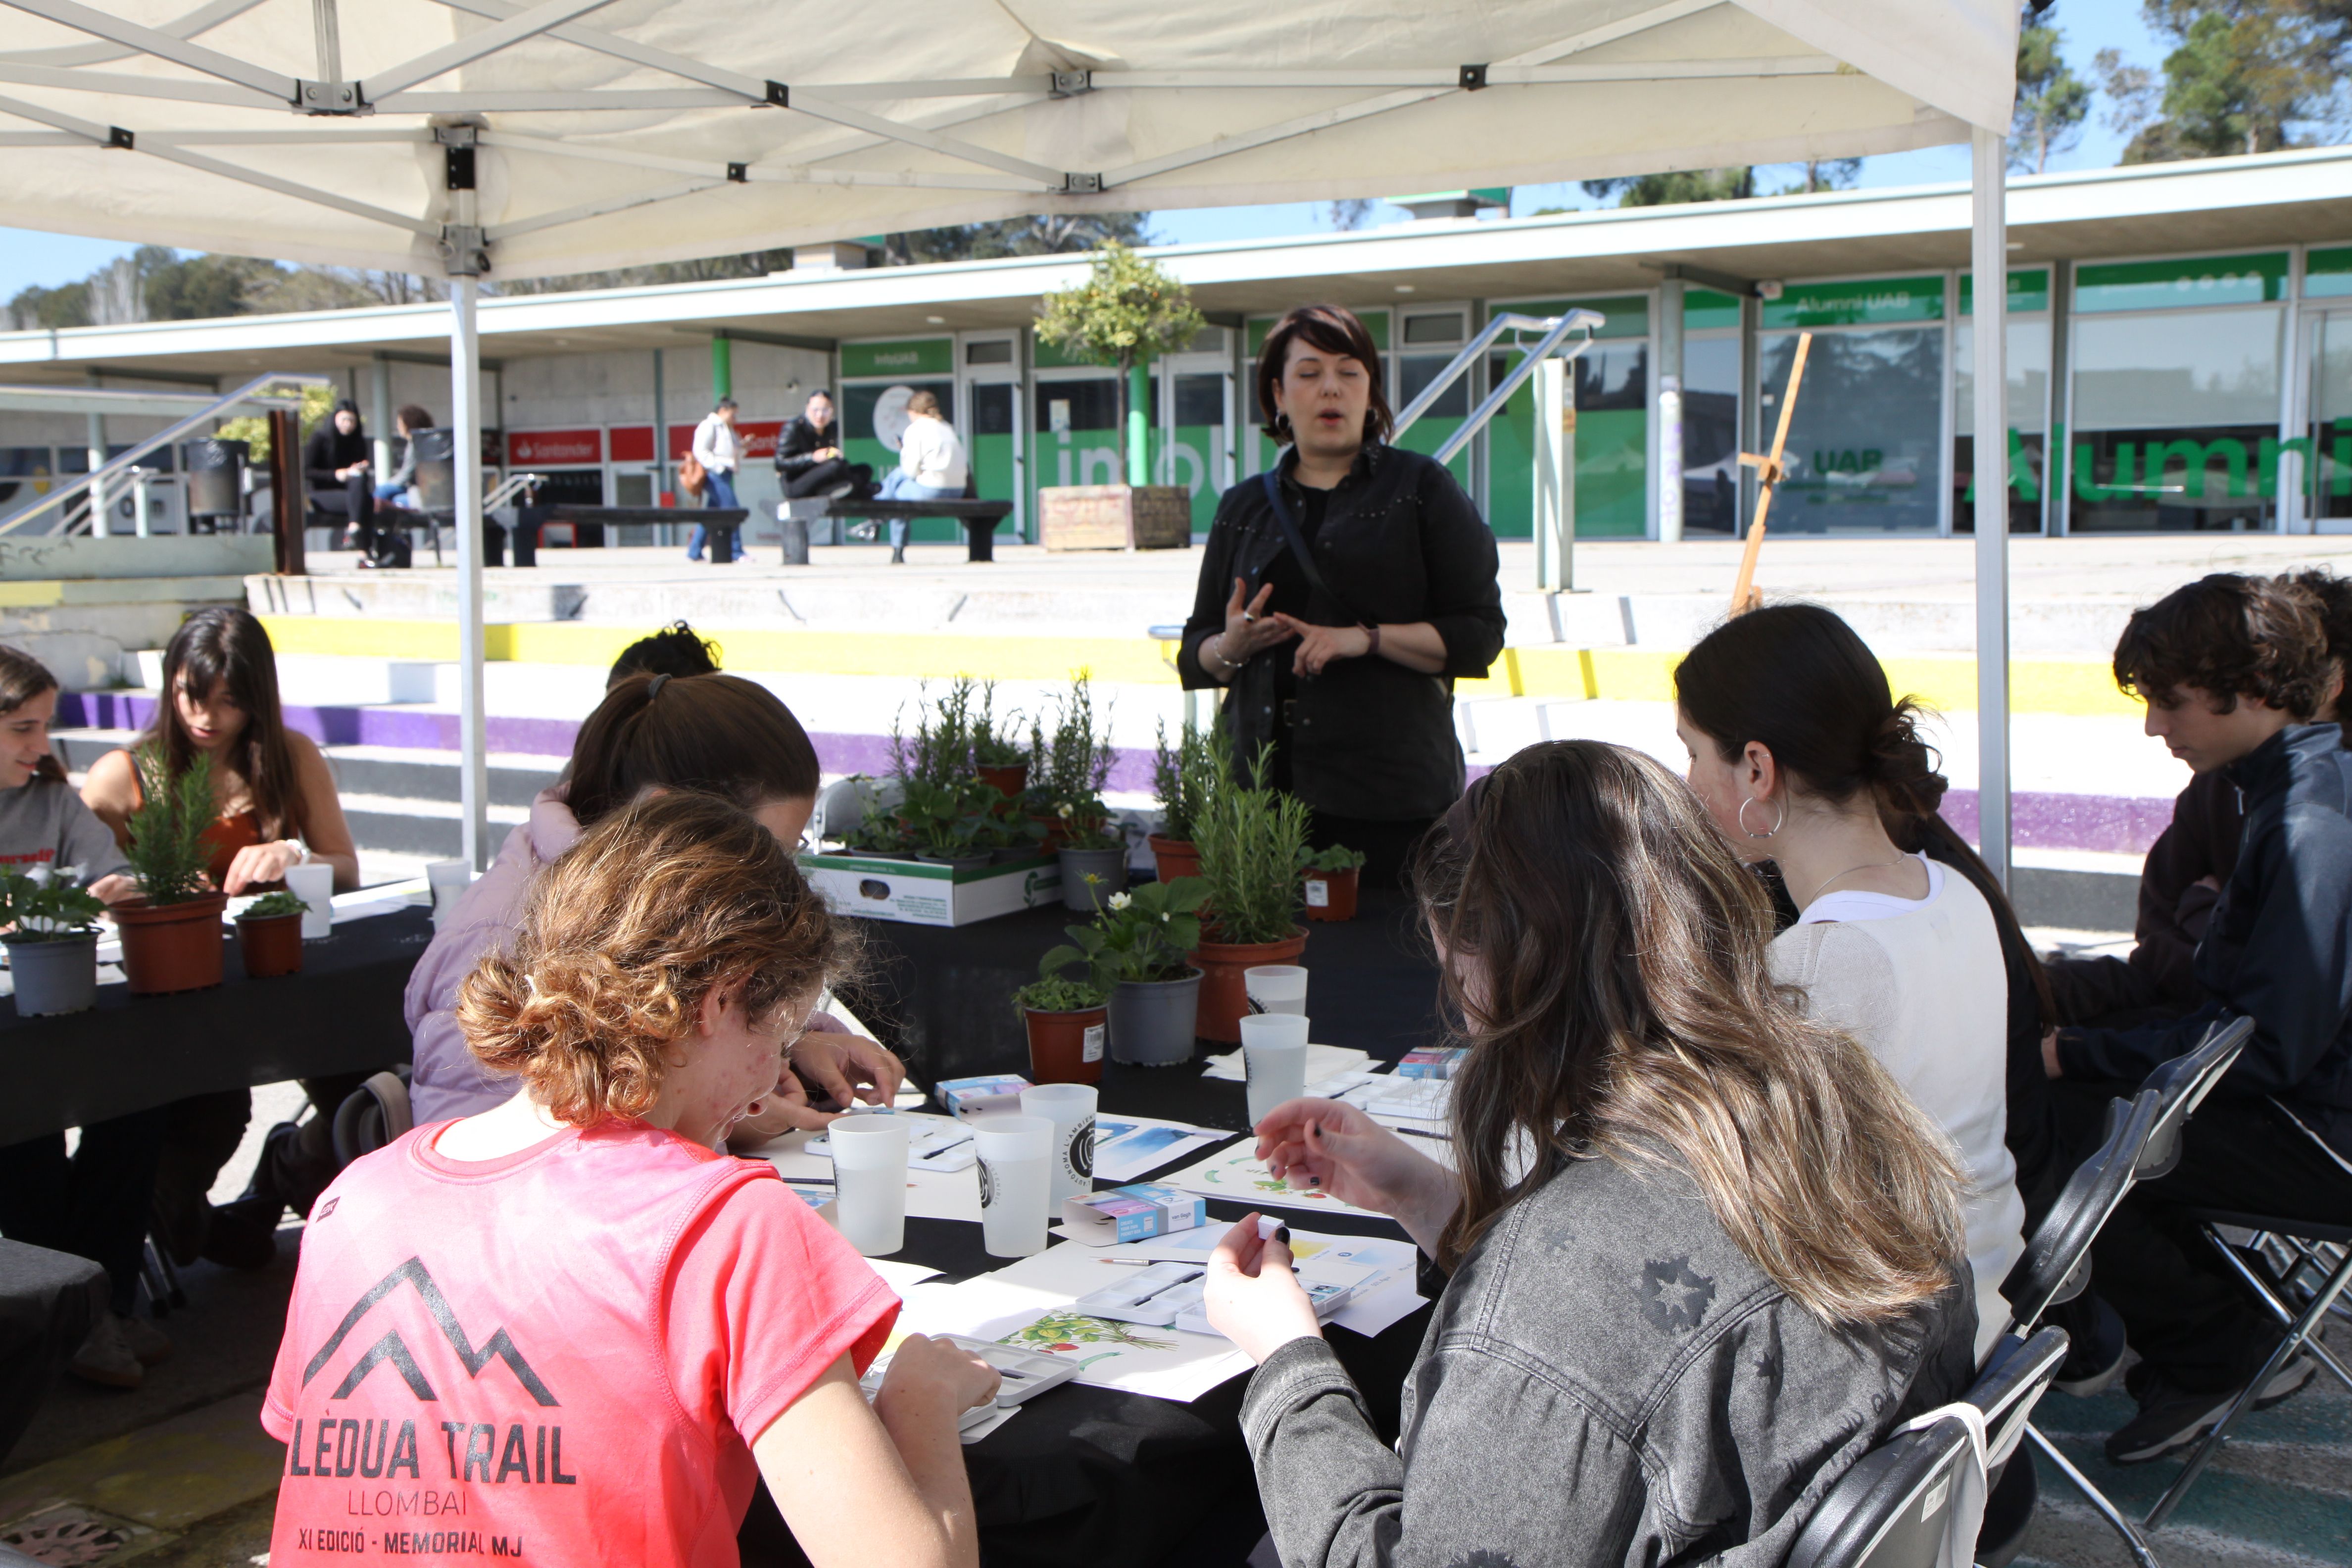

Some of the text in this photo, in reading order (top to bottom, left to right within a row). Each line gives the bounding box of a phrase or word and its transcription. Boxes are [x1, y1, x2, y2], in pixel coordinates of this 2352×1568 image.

[1796, 292, 1910, 312] Alumni UAB
[532, 441, 594, 458] Santander
[284, 1407, 577, 1485] LÈDUA TRAIL
[348, 1489, 467, 1517] LLOMBAI
[298, 1527, 313, 1550] XI
[317, 1526, 364, 1553] EDICIÓ
[384, 1531, 485, 1555] MEMORIAL
[492, 1535, 523, 1558] MJ
